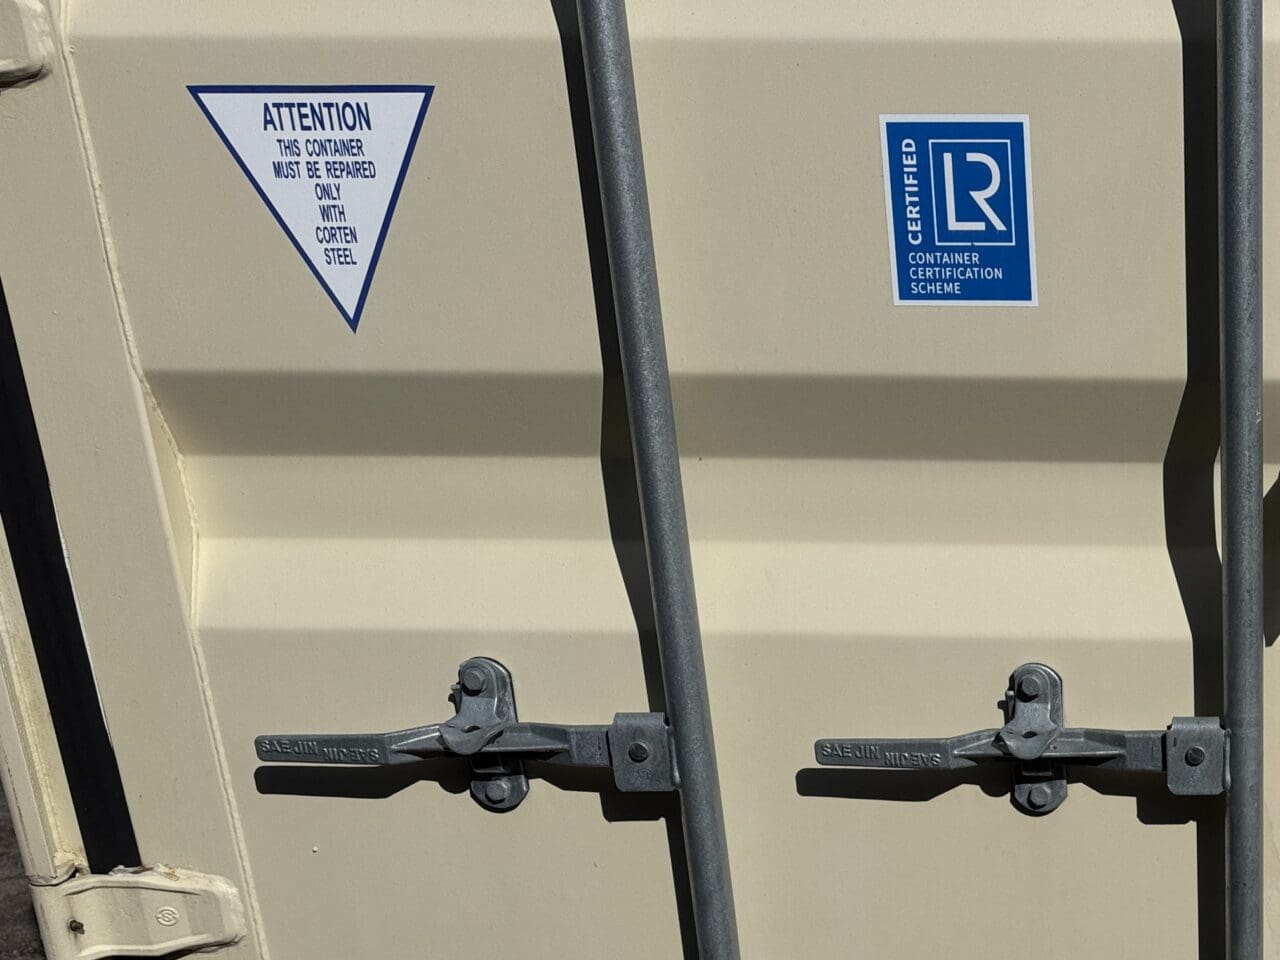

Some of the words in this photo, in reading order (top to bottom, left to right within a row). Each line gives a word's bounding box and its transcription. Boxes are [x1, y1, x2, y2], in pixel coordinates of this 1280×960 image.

[263, 101, 372, 131] ATTENTION
[276, 138, 301, 157] THIS
[305, 138, 365, 157] CONTAINER
[272, 160, 301, 179] MUST
[306, 160, 320, 179] BE
[326, 160, 377, 179] REPAIRED
[314, 182, 341, 201] ONLY
[901, 138, 923, 245] CERTIFIED
[943, 152, 1008, 231] LR
[318, 204, 347, 223] WITH
[315, 226, 358, 244] CORTEN
[323, 247, 357, 265] STEEL
[908, 252, 980, 264] CONTAINER
[909, 267, 1003, 279] CERTIFICATION
[910, 282, 961, 294] SCHEME
